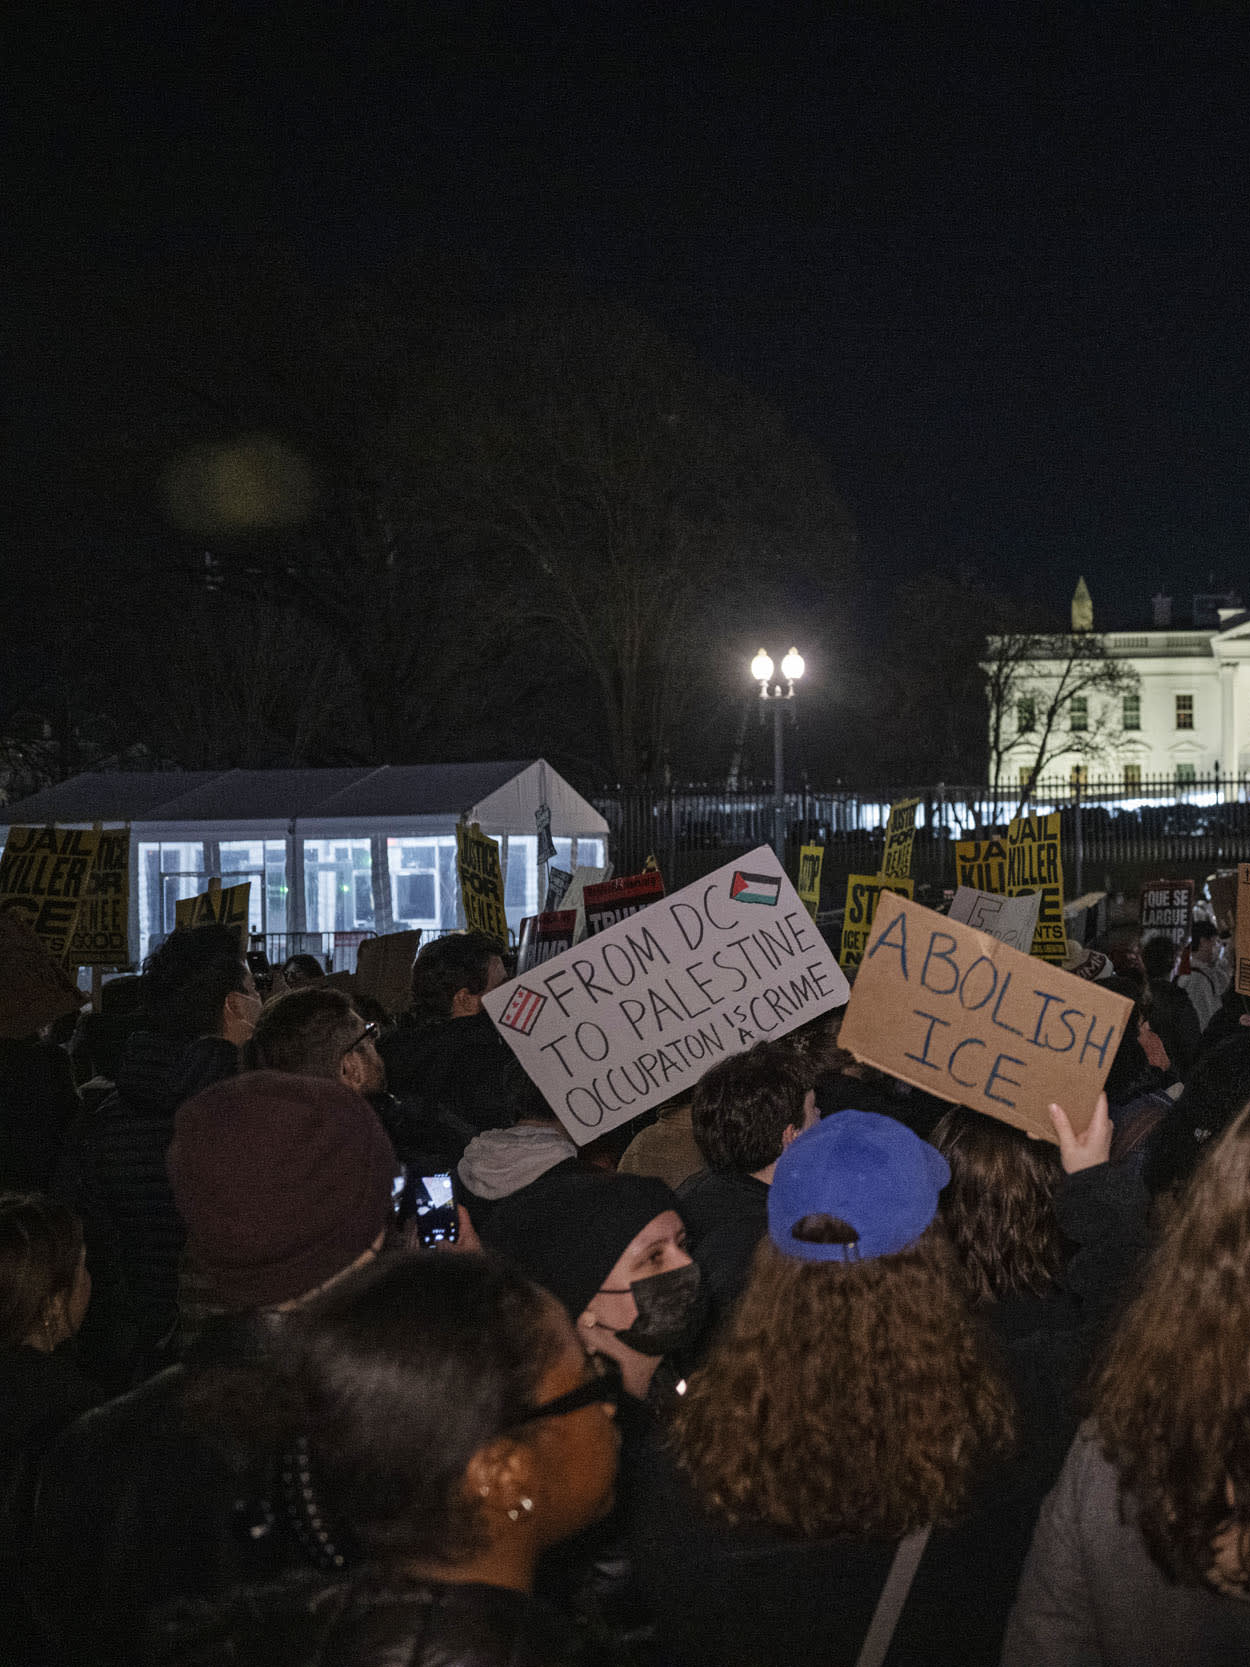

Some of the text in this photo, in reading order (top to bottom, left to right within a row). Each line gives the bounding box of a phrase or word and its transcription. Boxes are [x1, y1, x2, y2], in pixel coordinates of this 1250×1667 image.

[8, 829, 93, 857] JAIL
[1009, 817, 1058, 844] JAIL
[959, 841, 1007, 863] JA
[1008, 843, 1058, 887] KILLER
[1034, 924, 1063, 940] NTS
[1143, 909, 1188, 926] LARGUE
[543, 885, 739, 1018] FROM DC
[540, 912, 817, 1078] TO PALESTINE
[736, 961, 835, 1045] A CRIME
[868, 911, 1115, 1068] ABOLISH
[722, 1004, 747, 1028] IS
[904, 1010, 1027, 1108] ICE
